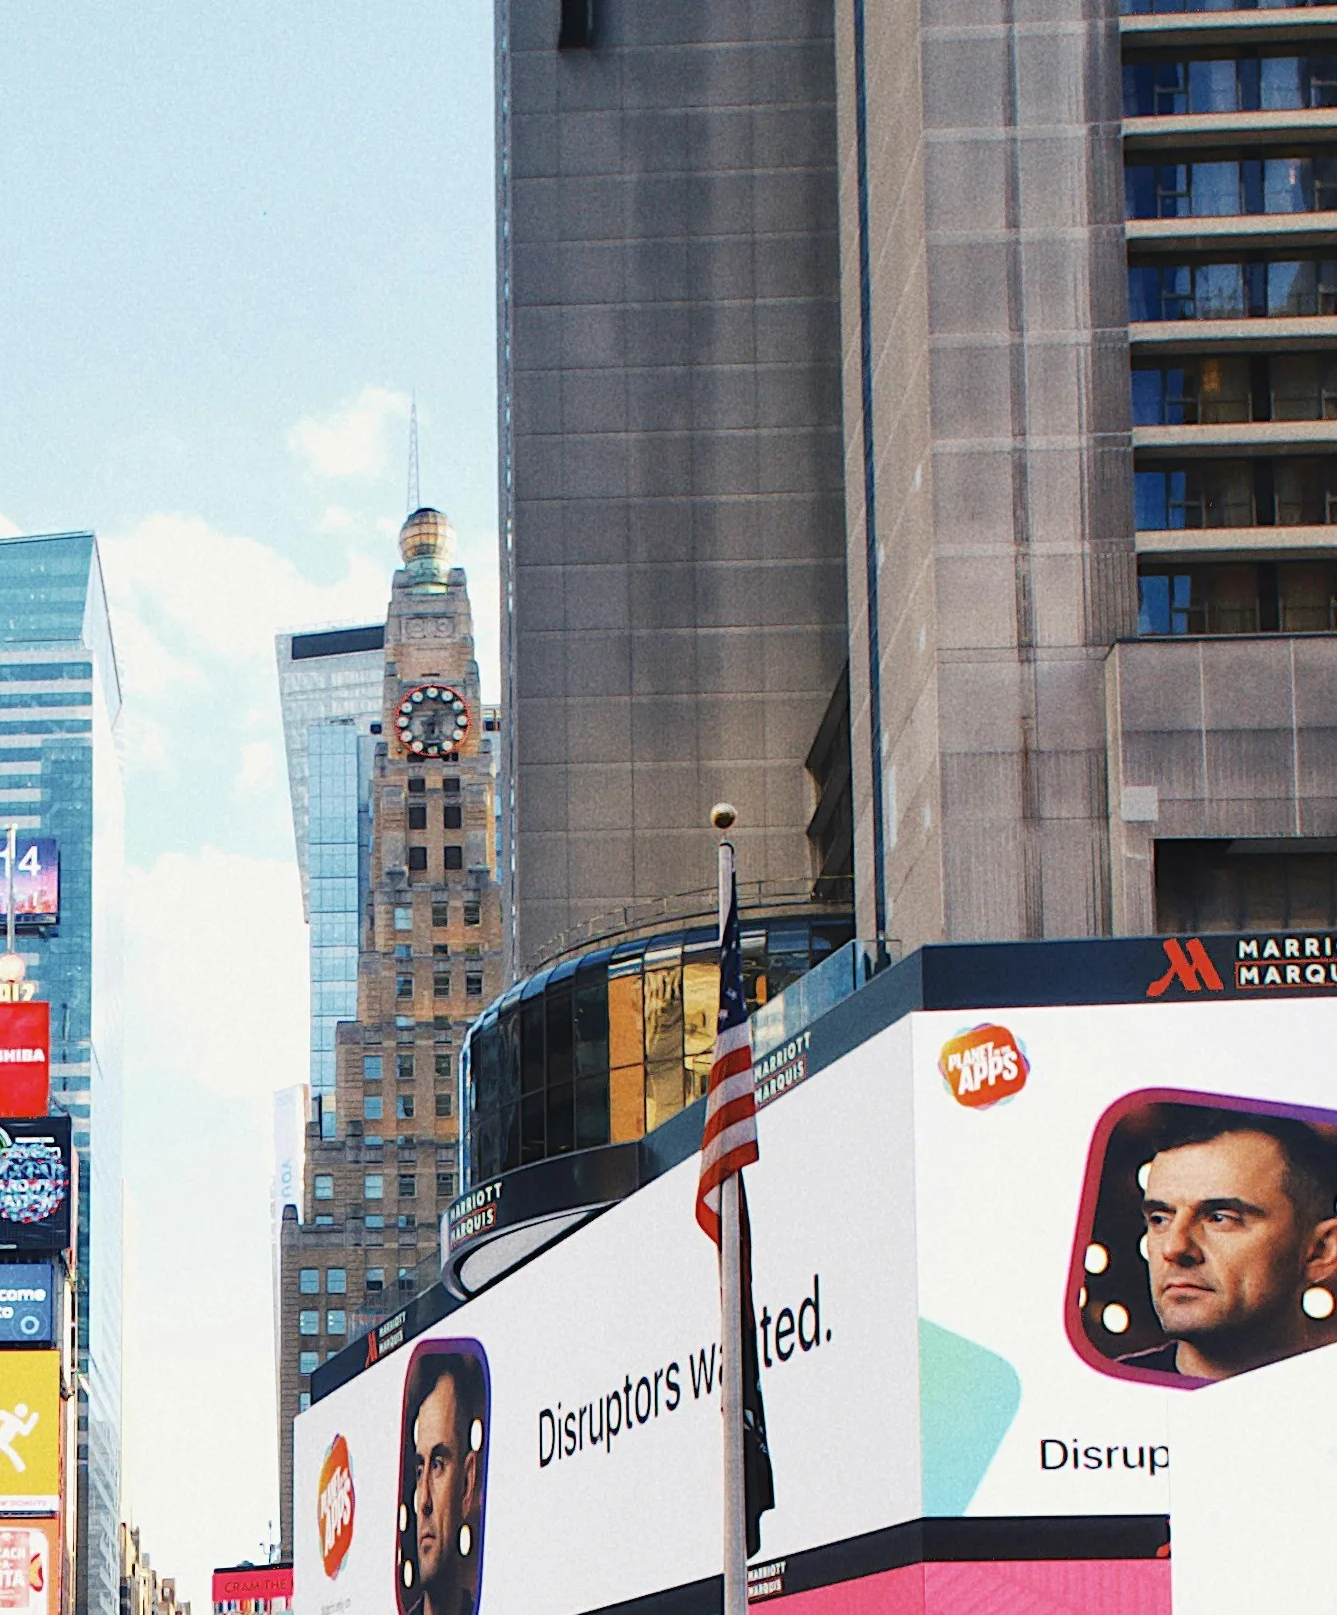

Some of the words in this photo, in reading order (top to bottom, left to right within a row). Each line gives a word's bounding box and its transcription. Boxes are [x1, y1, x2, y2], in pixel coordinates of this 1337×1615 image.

[1238, 937, 1337, 959] MARRI
[755, 1031, 811, 1082] MARRIOTT
[958, 1051, 1018, 1096] APPS
[539, 1361, 681, 1468] Disruptors
[689, 1273, 832, 1400] wted.
[1041, 1439, 1169, 1476] Disrup
[224, 1580, 260, 1594] CRAM
[265, 1579, 286, 1590] THE
